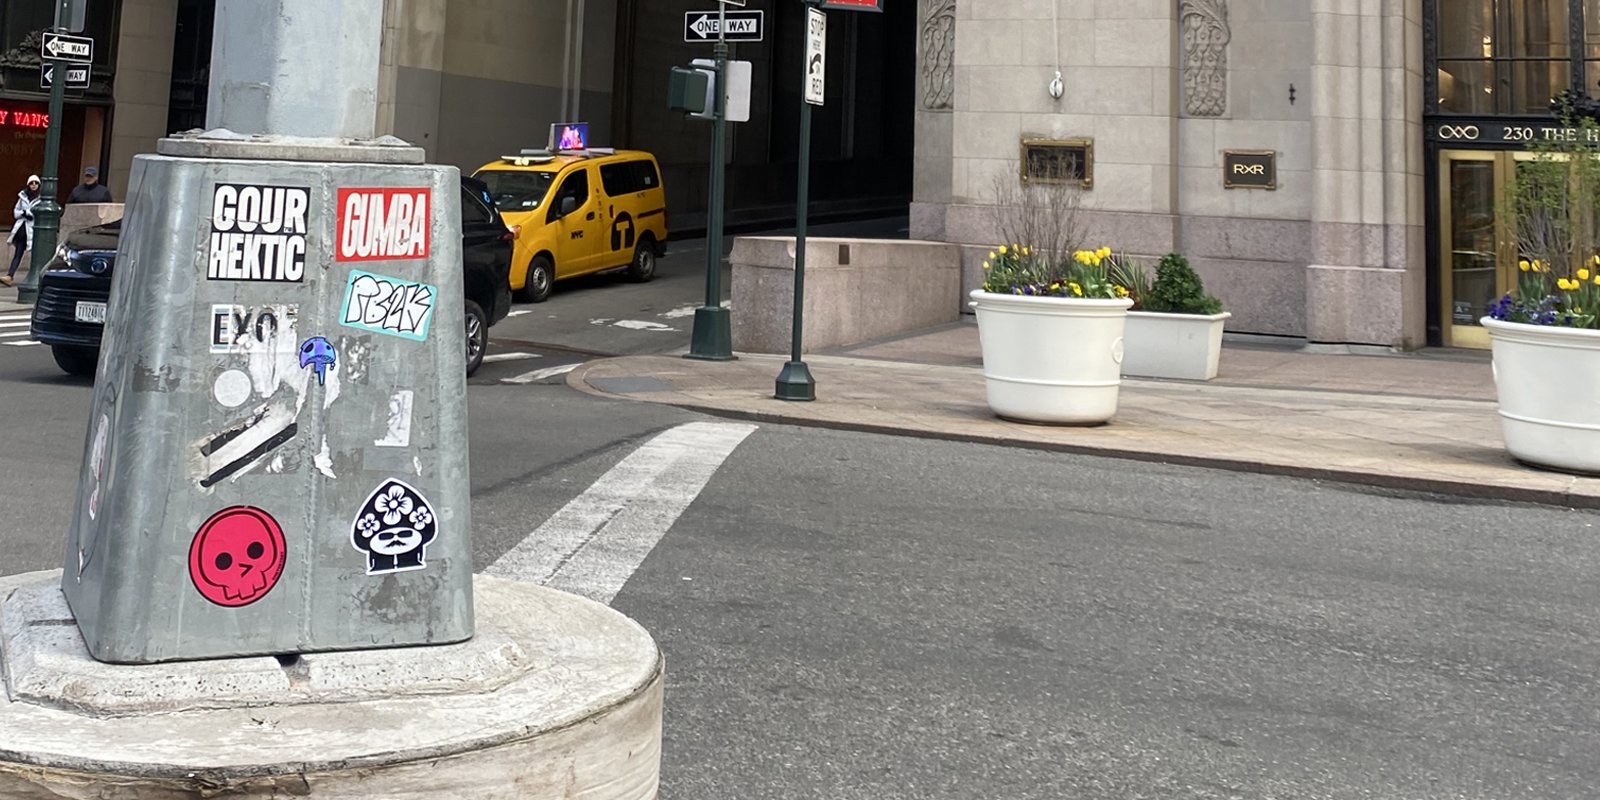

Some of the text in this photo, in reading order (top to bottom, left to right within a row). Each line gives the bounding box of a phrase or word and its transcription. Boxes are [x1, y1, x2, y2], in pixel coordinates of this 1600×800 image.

[697, 21, 752, 32] ONE WAY
[810, 18, 824, 38] STOP
[50, 41, 87, 54] ONE WAY
[68, 71, 84, 81] WAY
[812, 78, 822, 96] RED
[13, 112, 49, 128] VAN'S
[1503, 127, 1533, 140] 230
[1541, 127, 1577, 141] THE
[1233, 163, 1265, 175] RXR
[212, 185, 309, 234] GOUR
[341, 192, 426, 258] GUMBA
[570, 230, 584, 240] NYC
[208, 232, 305, 282] HEKTIC
